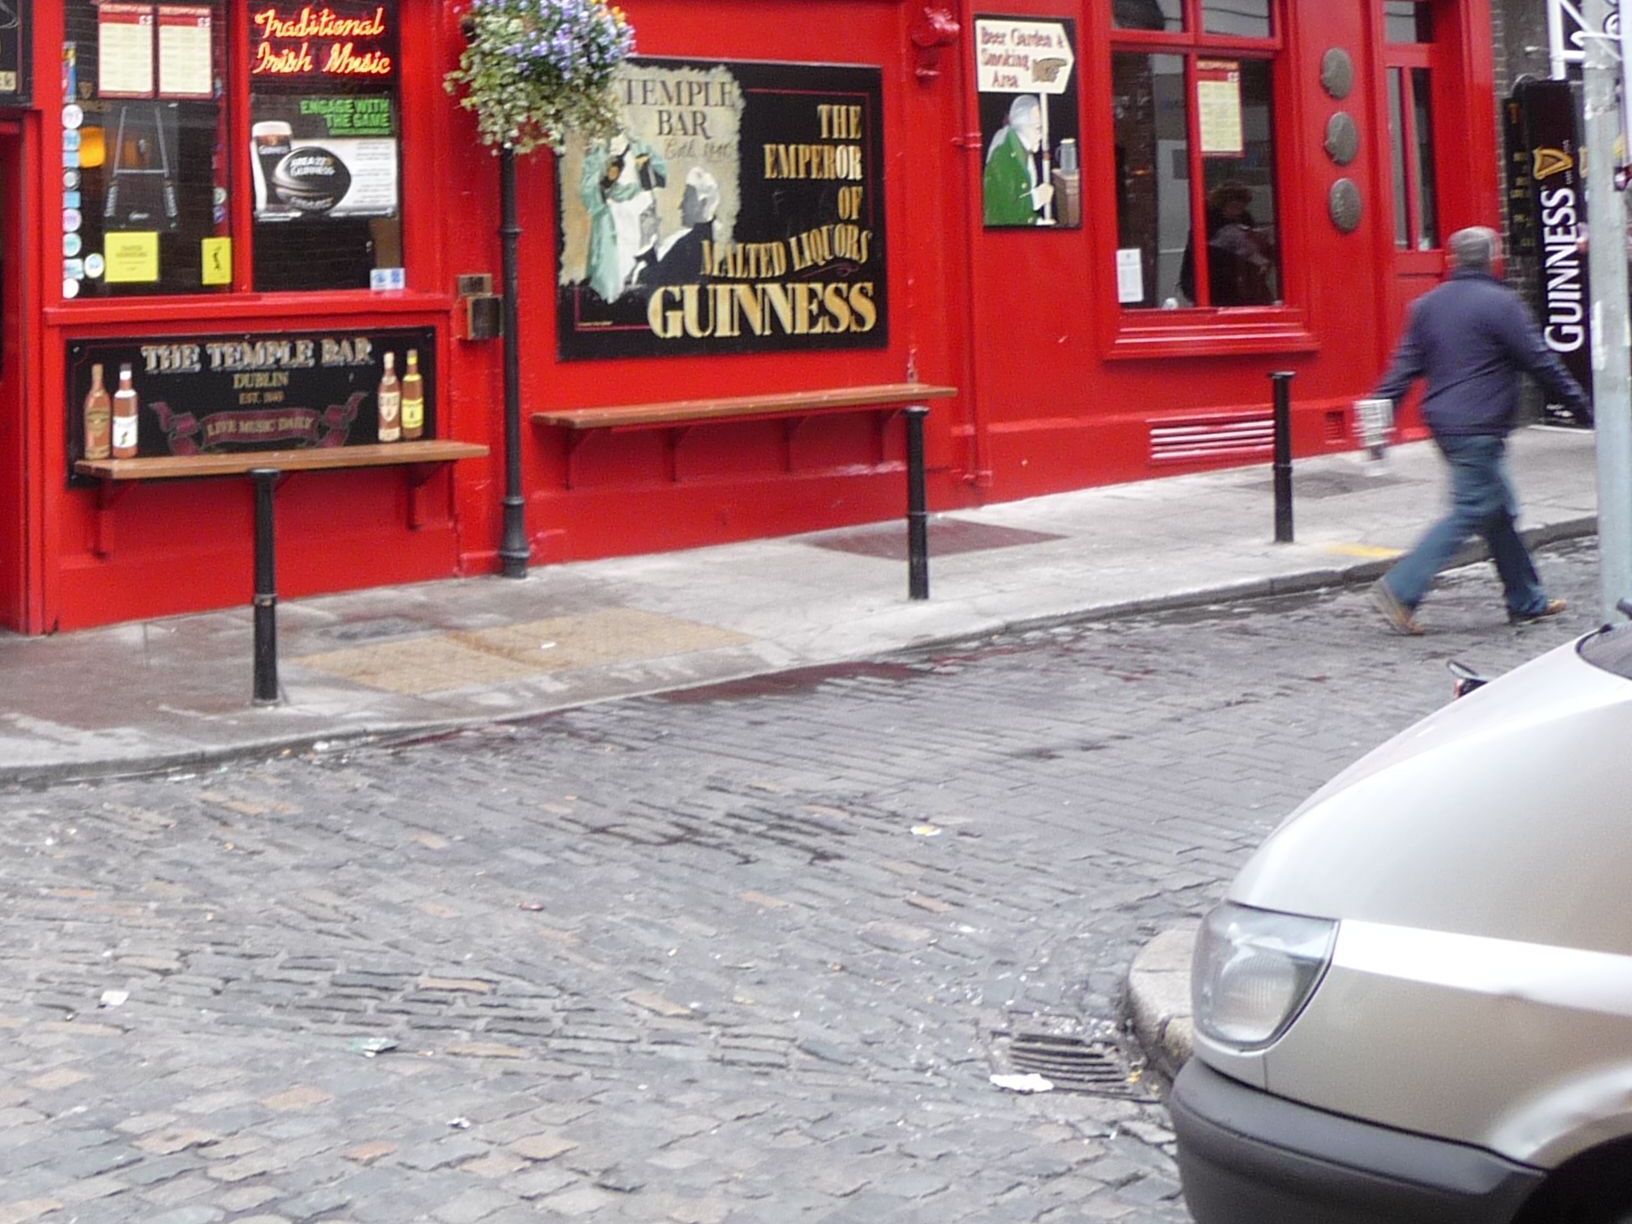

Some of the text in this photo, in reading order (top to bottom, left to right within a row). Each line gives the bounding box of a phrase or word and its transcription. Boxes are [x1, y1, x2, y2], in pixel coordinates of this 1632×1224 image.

[254, 6, 385, 39] Traditional
[980, 26, 1006, 45] Beer
[1010, 27, 1052, 48] Garden
[252, 41, 392, 75] Irish Music
[980, 47, 1030, 72] Smoking
[622, 78, 738, 108] TEMPLE
[991, 69, 1020, 89] Area
[299, 98, 391, 115] ENGAGE WITH
[325, 113, 391, 128] THE GAME
[817, 104, 862, 140] THE
[655, 109, 713, 139] BAR
[763, 143, 863, 180] EMPEROR
[837, 185, 864, 221] OF
[700, 223, 873, 279] MALTED LIQUORS
[1540, 187, 1585, 353] GUINNESS
[646, 281, 878, 339] GUINNESS
[140, 336, 374, 376] THE TEMPLE BAR
[232, 371, 289, 389] DUBLIN
[206, 416, 315, 437] LIVE MUSIC DAILY
